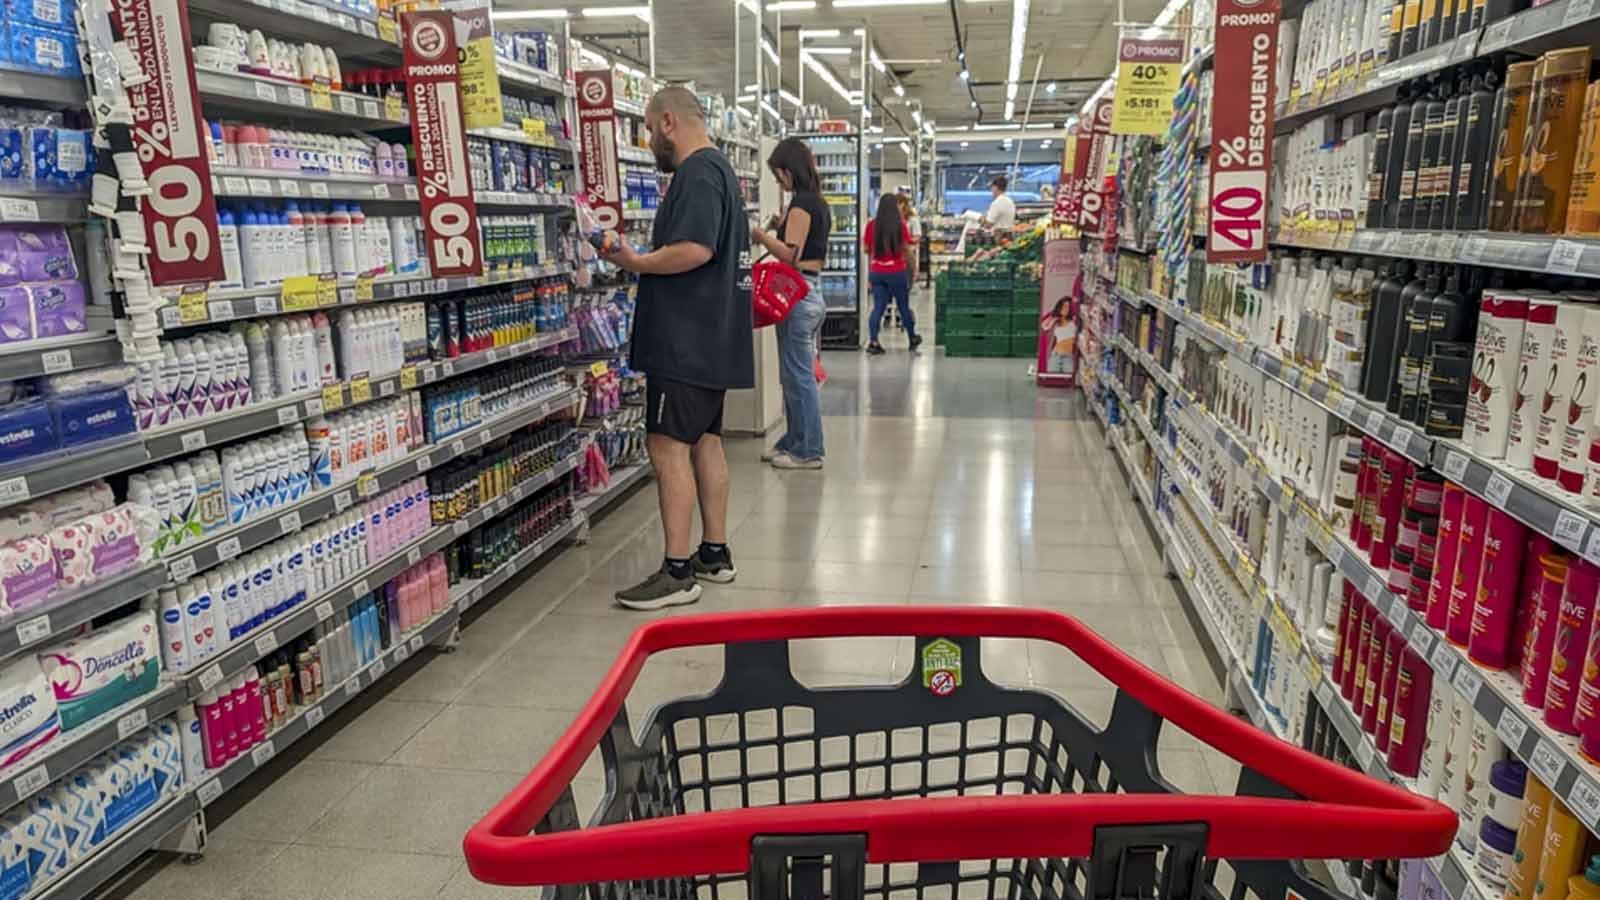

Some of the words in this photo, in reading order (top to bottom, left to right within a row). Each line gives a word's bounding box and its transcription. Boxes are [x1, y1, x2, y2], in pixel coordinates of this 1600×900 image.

[1221, 13, 1275, 26] PROMO!
[408, 64, 456, 76] PROMO!
[1137, 46, 1179, 57] PROMO!
[1248, 33, 1270, 166] DESCUENTO
[414, 84, 434, 170] DESCUENTO
[584, 123, 597, 183] DESCUENTO
[83, 641, 145, 679] Doncella
